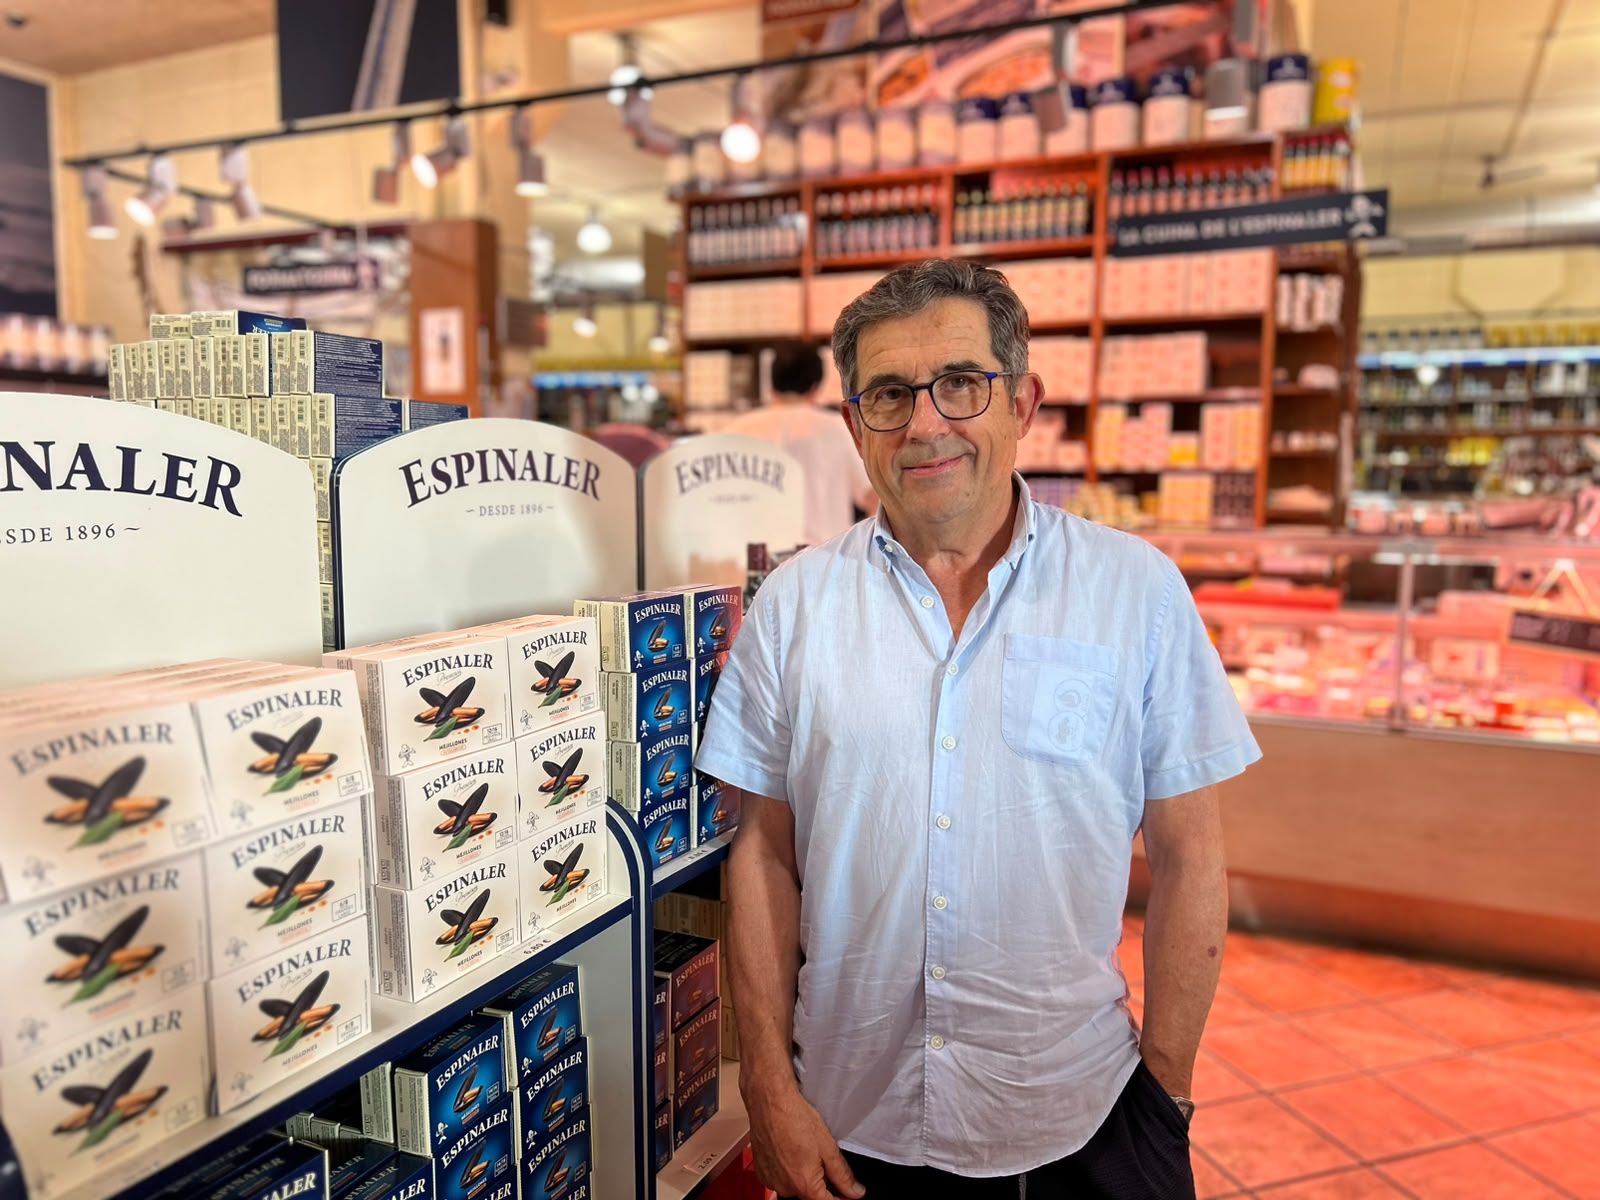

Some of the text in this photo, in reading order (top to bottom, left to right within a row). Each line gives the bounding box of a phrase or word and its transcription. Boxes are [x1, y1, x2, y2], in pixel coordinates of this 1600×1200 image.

[1119, 226, 1140, 247] LA
[1142, 222, 1198, 245] CUINA
[1201, 218, 1226, 239] DE
[398, 447, 601, 509] ESPINALER
[675, 451, 786, 495] ESPINALER
[479, 503, 544, 517] DESDE 1896
[0, 522, 116, 545] SDE 1896
[634, 602, 681, 624] ESPINALER
[699, 593, 739, 612] ESPINALER
[522, 630, 587, 660] ESPINALER
[402, 652, 493, 688] ESPINALER
[642, 669, 688, 693] ESPINALER
[226, 688, 343, 731] ESPINALER
[10, 722, 174, 776] ESPINALER
[530, 726, 596, 762] ESPINALER
[646, 733, 689, 762] ESPINALER
[422, 758, 504, 801] ESPINALER
[643, 798, 687, 829] ESPINALER
[231, 815, 345, 868] ESPINALER
[531, 820, 597, 863] ESPINALER
[24, 869, 179, 937] ESPINALER
[424, 862, 506, 913] ESPINALER
[237, 938, 352, 1005] ESPINALER
[676, 952, 715, 987] ESPINALER
[520, 981, 574, 1029] ESPINALER
[680, 1009, 717, 1047] ESPINALER
[31, 1010, 182, 1092] ESPINALER
[436, 1034, 499, 1092] ESPINALER
[526, 1051, 582, 1103] ESPINALER
[679, 1067, 716, 1108] ESPINALER
[441, 1108, 508, 1169] ESPINALER
[528, 1119, 586, 1174] ESPINALER
[484, 1183, 511, 1200] LER
